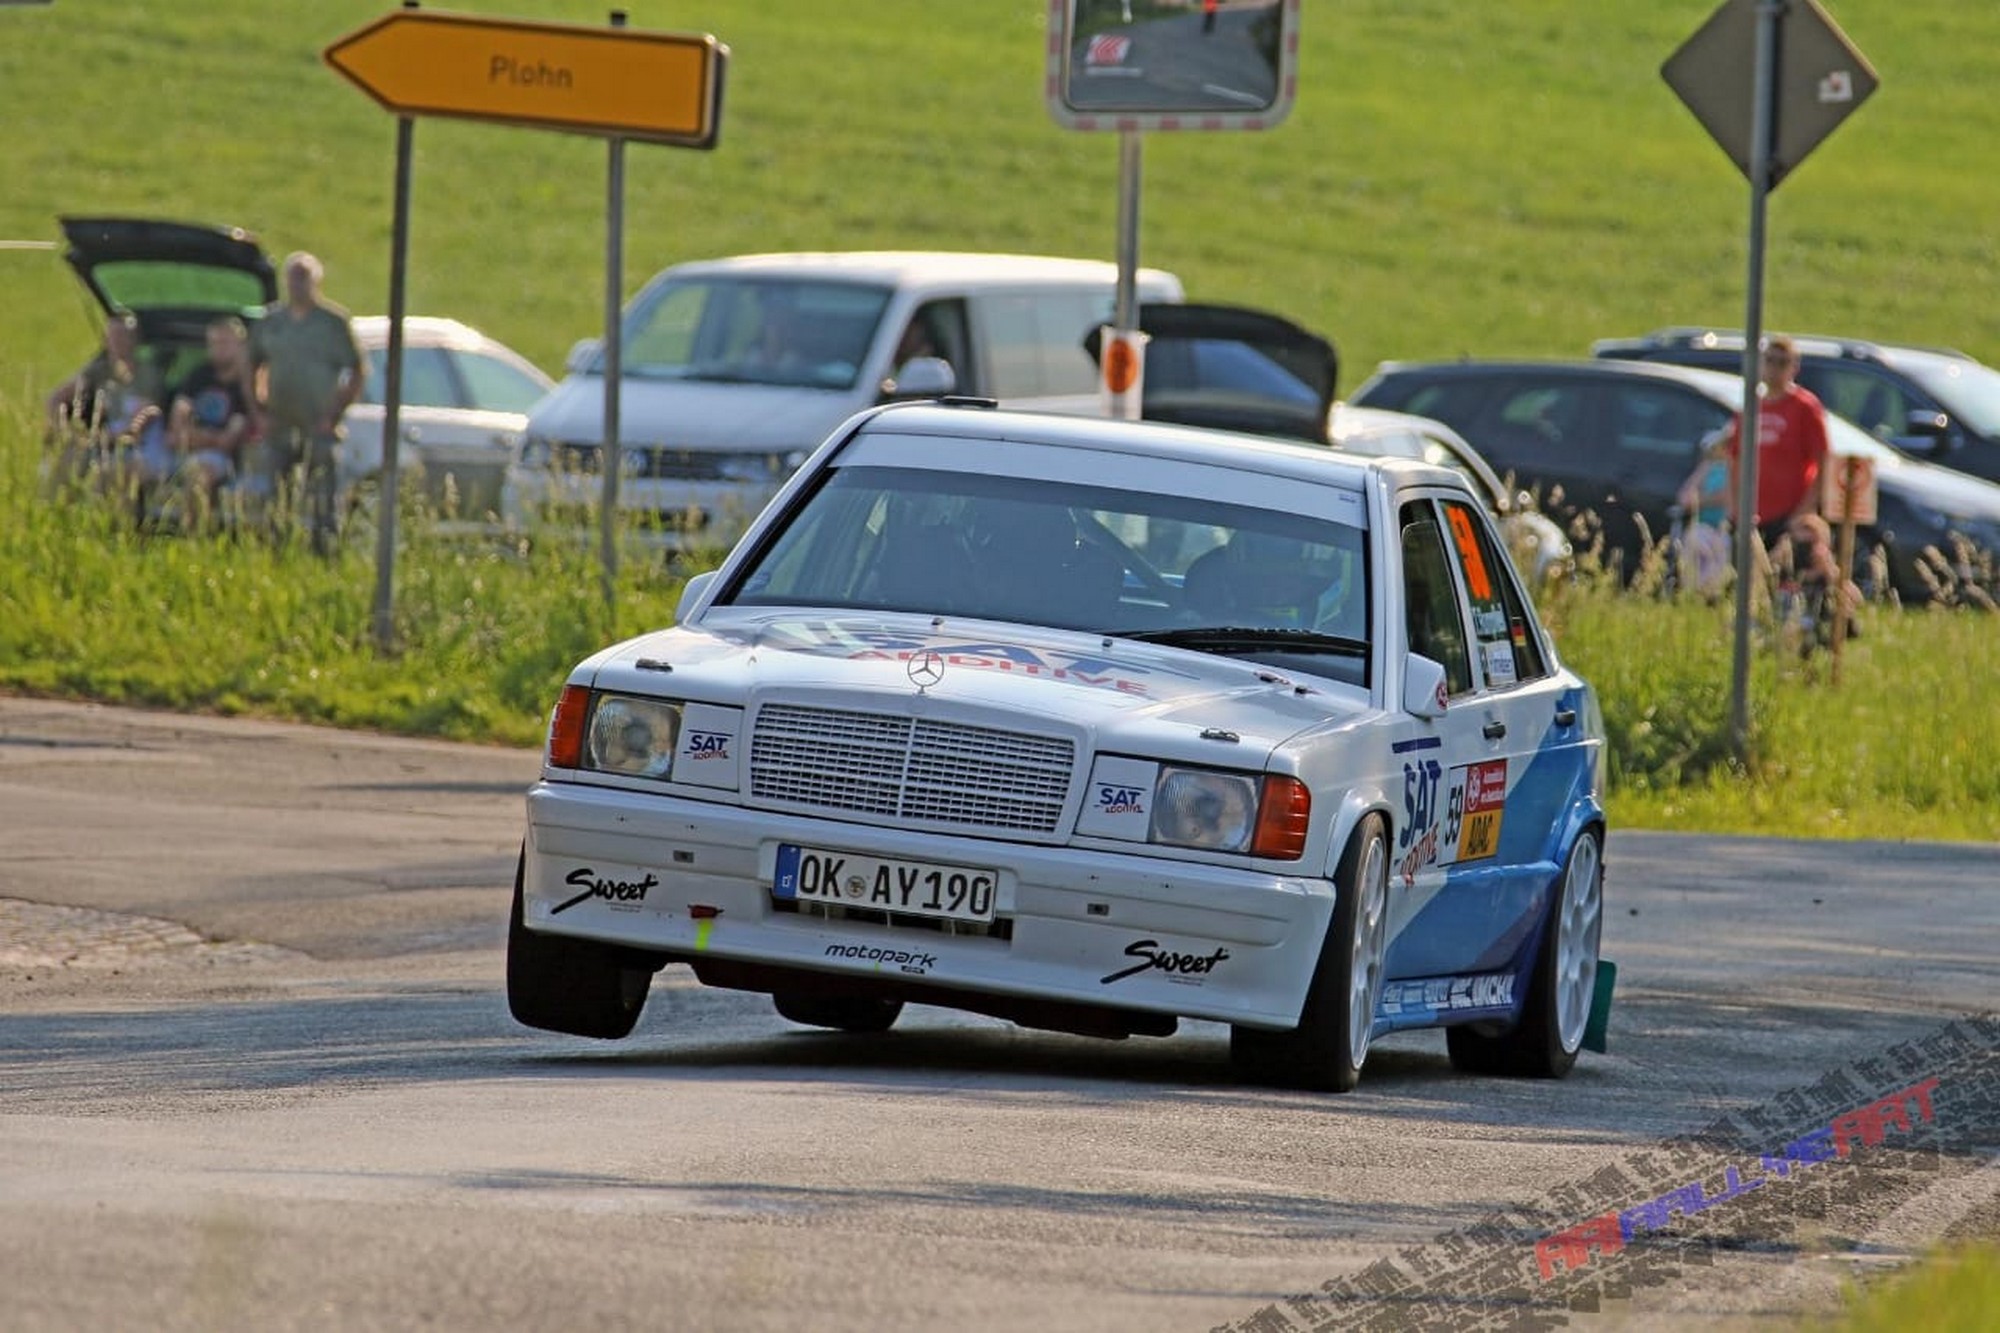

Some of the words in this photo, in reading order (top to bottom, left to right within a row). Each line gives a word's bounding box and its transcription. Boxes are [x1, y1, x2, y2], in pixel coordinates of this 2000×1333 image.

[488, 54, 573, 88] Plohn
[689, 734, 729, 751] SAT
[1100, 787, 1141, 806] SAT
[1400, 759, 1442, 848] SAT
[1445, 784, 1464, 846] 59
[550, 868, 660, 915] Sweet
[800, 854, 846, 899] OK
[825, 943, 938, 968] motopark
[1099, 939, 1230, 984] Sweet
